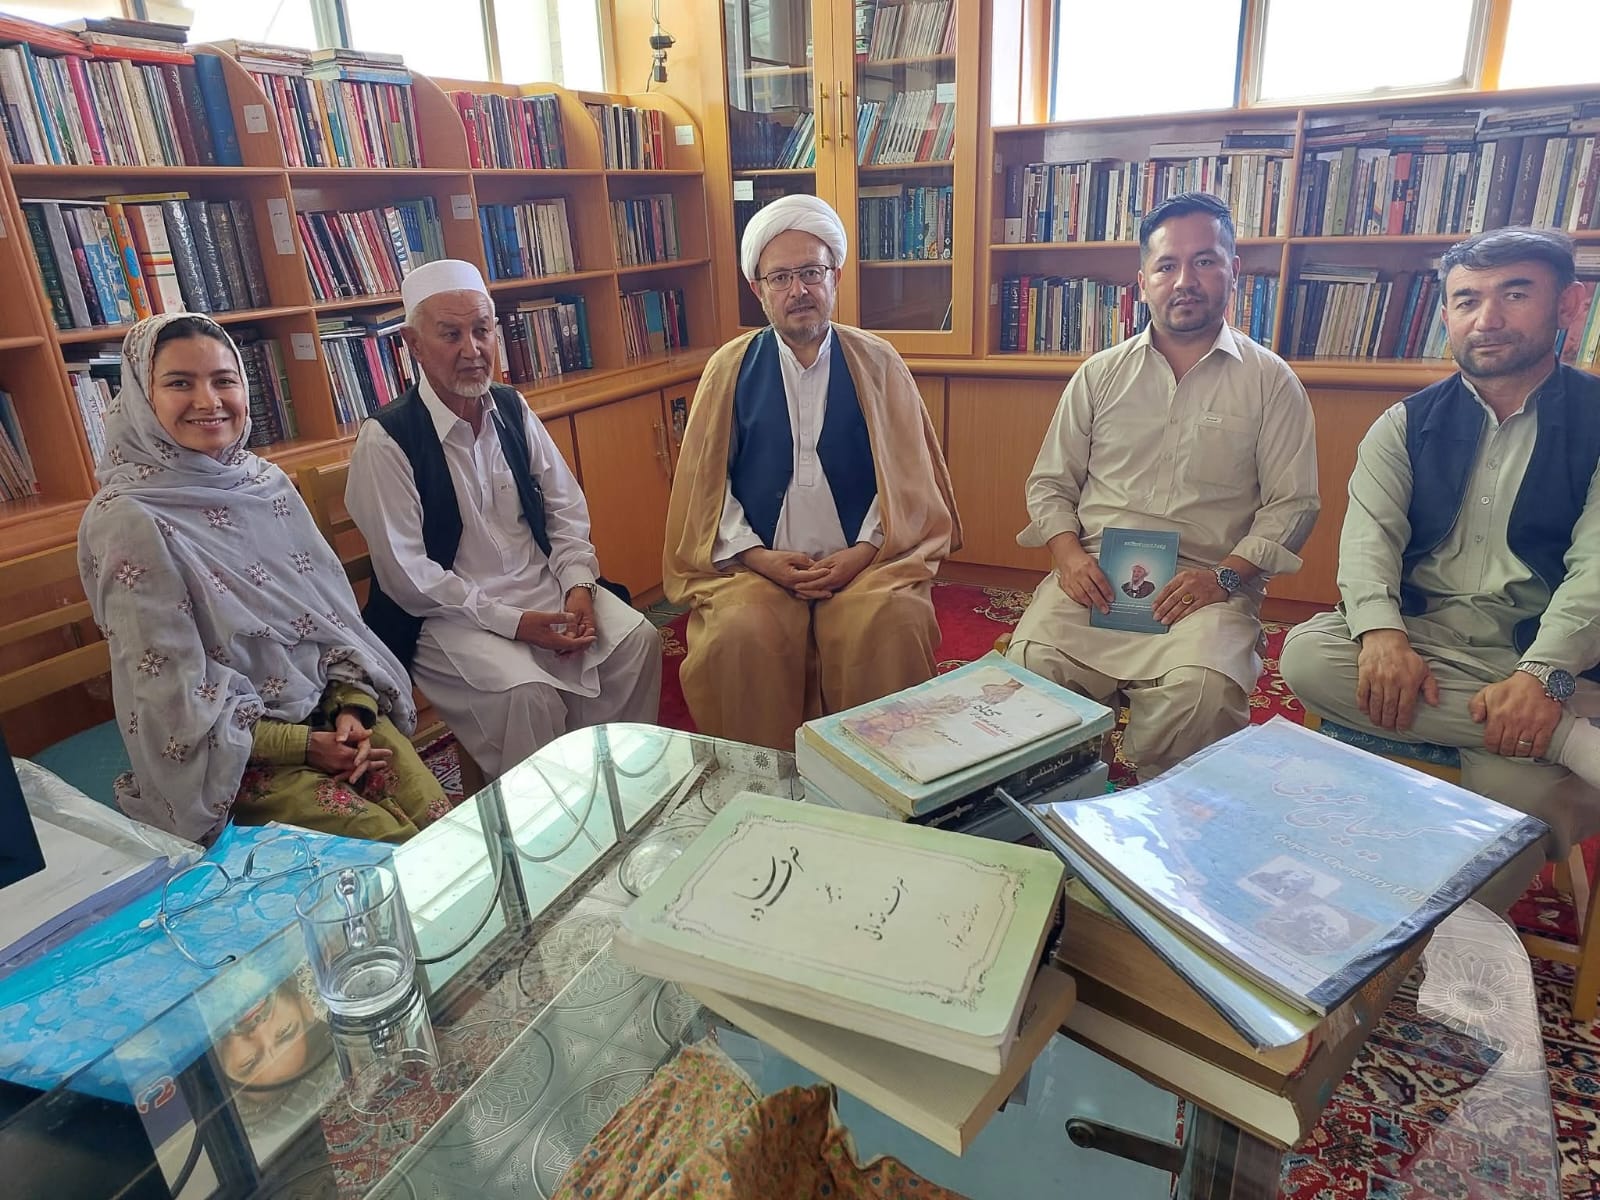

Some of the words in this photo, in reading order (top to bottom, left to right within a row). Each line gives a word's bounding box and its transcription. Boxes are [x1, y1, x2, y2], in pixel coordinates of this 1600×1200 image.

[732, 855, 777, 922] ساده
[757, 846, 804, 907] صرف
[1273, 833, 1327, 860] General
[1324, 854, 1393, 890] Chemistry
[854, 908, 886, 941] مقدماتی
[882, 876, 909, 916] صرف
